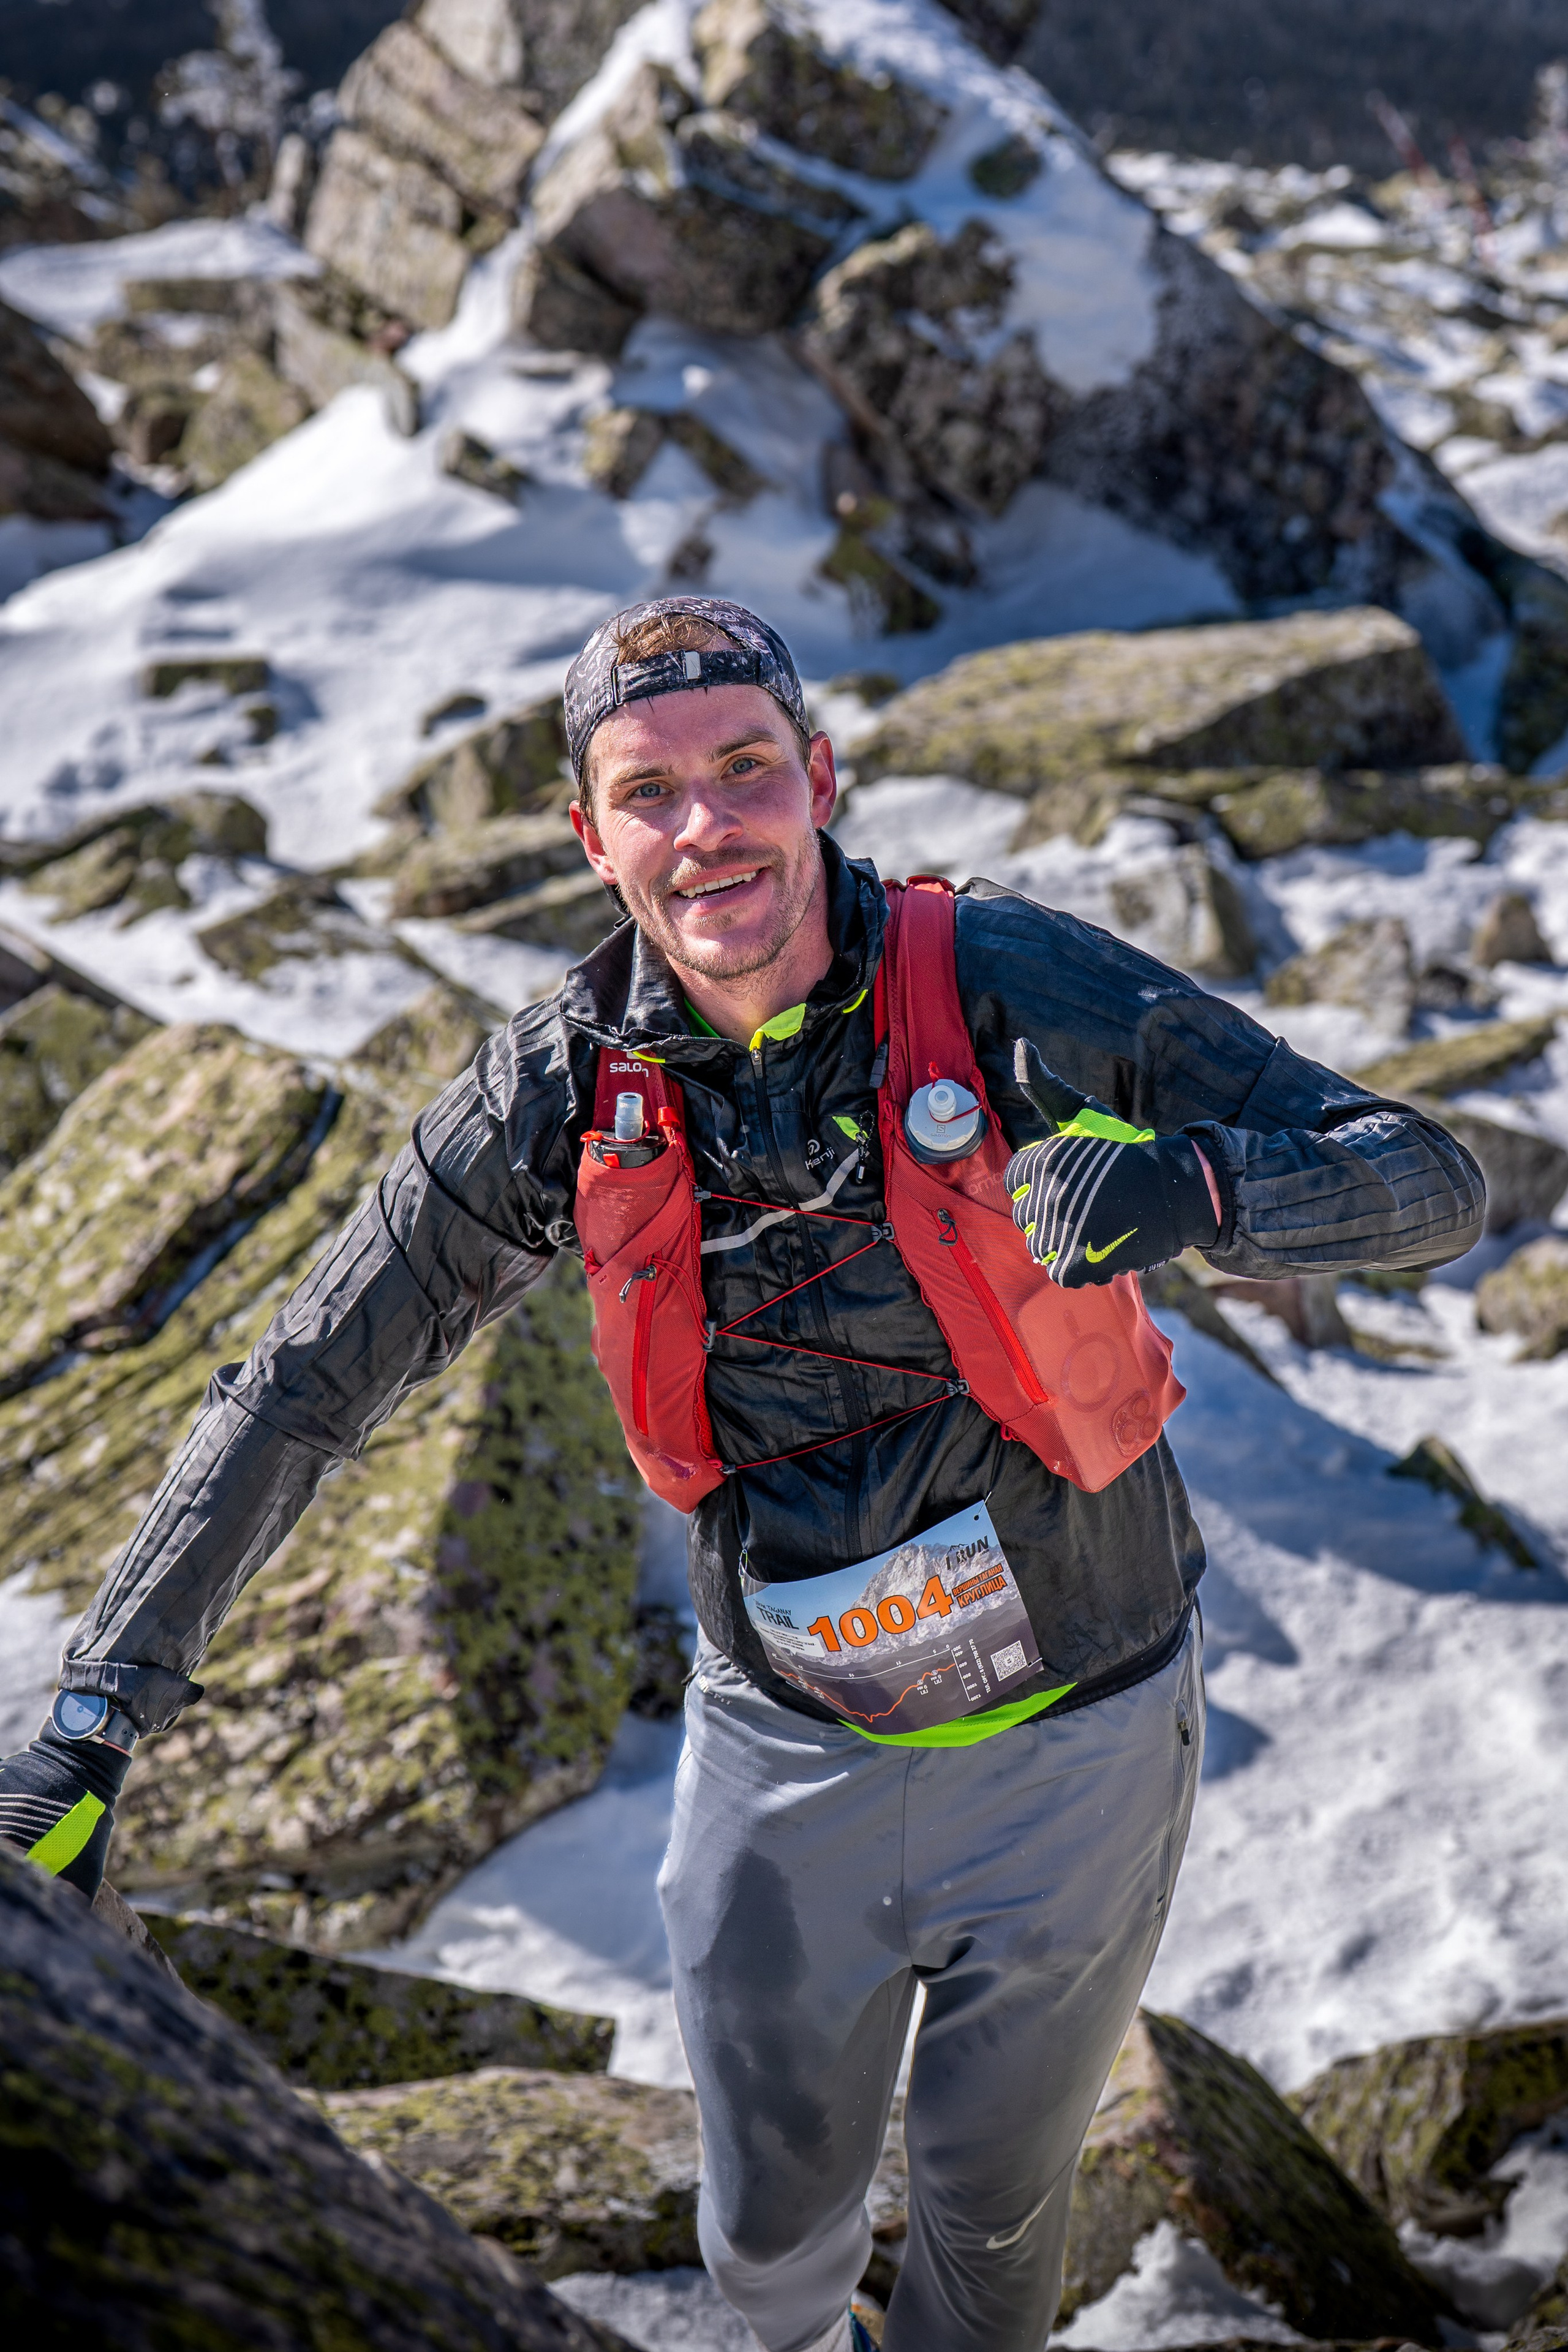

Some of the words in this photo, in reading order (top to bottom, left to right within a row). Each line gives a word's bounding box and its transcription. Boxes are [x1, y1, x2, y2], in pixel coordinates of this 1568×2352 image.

[956, 1535, 989, 1564] RUN
[952, 1577, 979, 1596] ВЕРШИНЫ
[979, 1564, 1003, 1581] ТАГАНАЯ
[957, 1575, 1008, 1608] КРУГЛИЦА
[756, 1606, 799, 1630] TRAIL
[766, 1605, 791, 1616] TAGANAY
[807, 1574, 954, 1653] 1004
